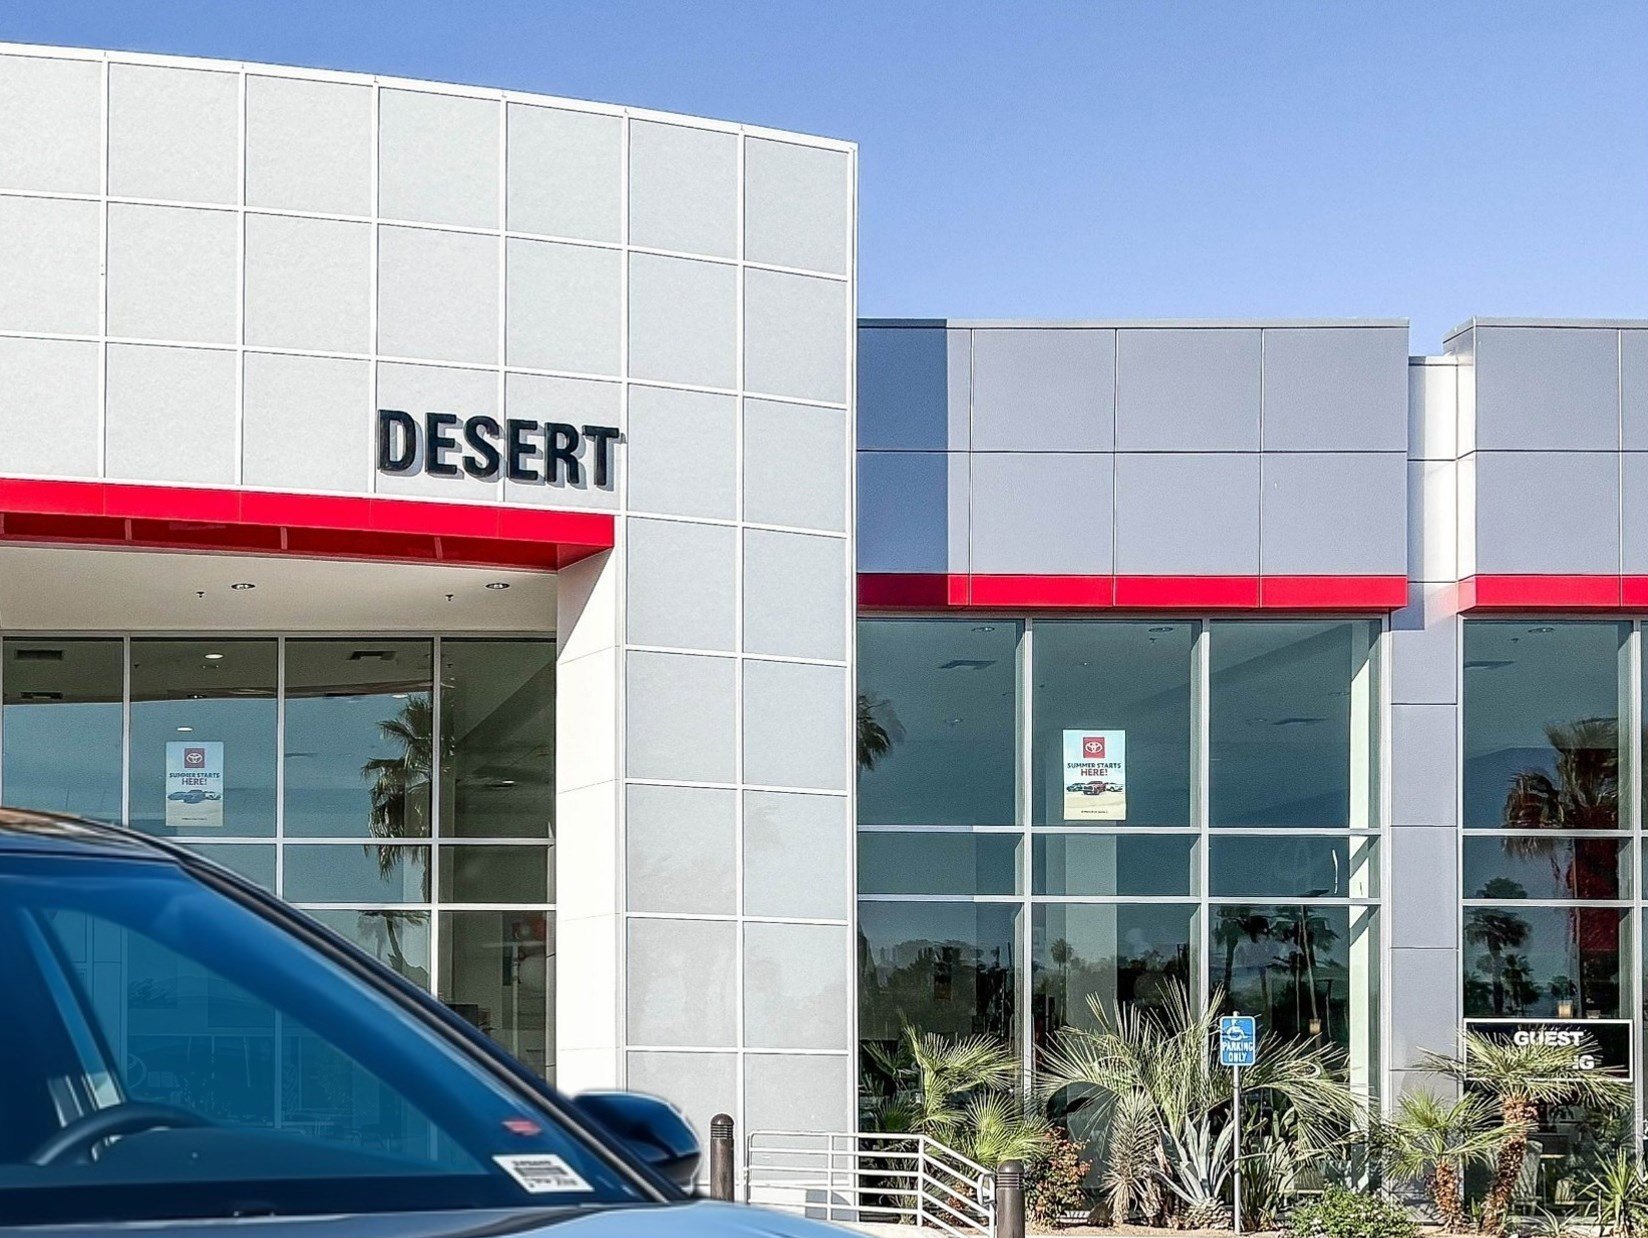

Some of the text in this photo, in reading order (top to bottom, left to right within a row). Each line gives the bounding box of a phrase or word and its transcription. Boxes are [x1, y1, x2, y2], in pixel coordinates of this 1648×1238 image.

[377, 409, 620, 487] DESERT
[1080, 768, 1108, 777] HERE!
[181, 778, 208, 786] HERE!
[1513, 1030, 1584, 1047] GUEST
[1222, 1041, 1253, 1052] PARKING
[1228, 1051, 1247, 1062] ONLY
